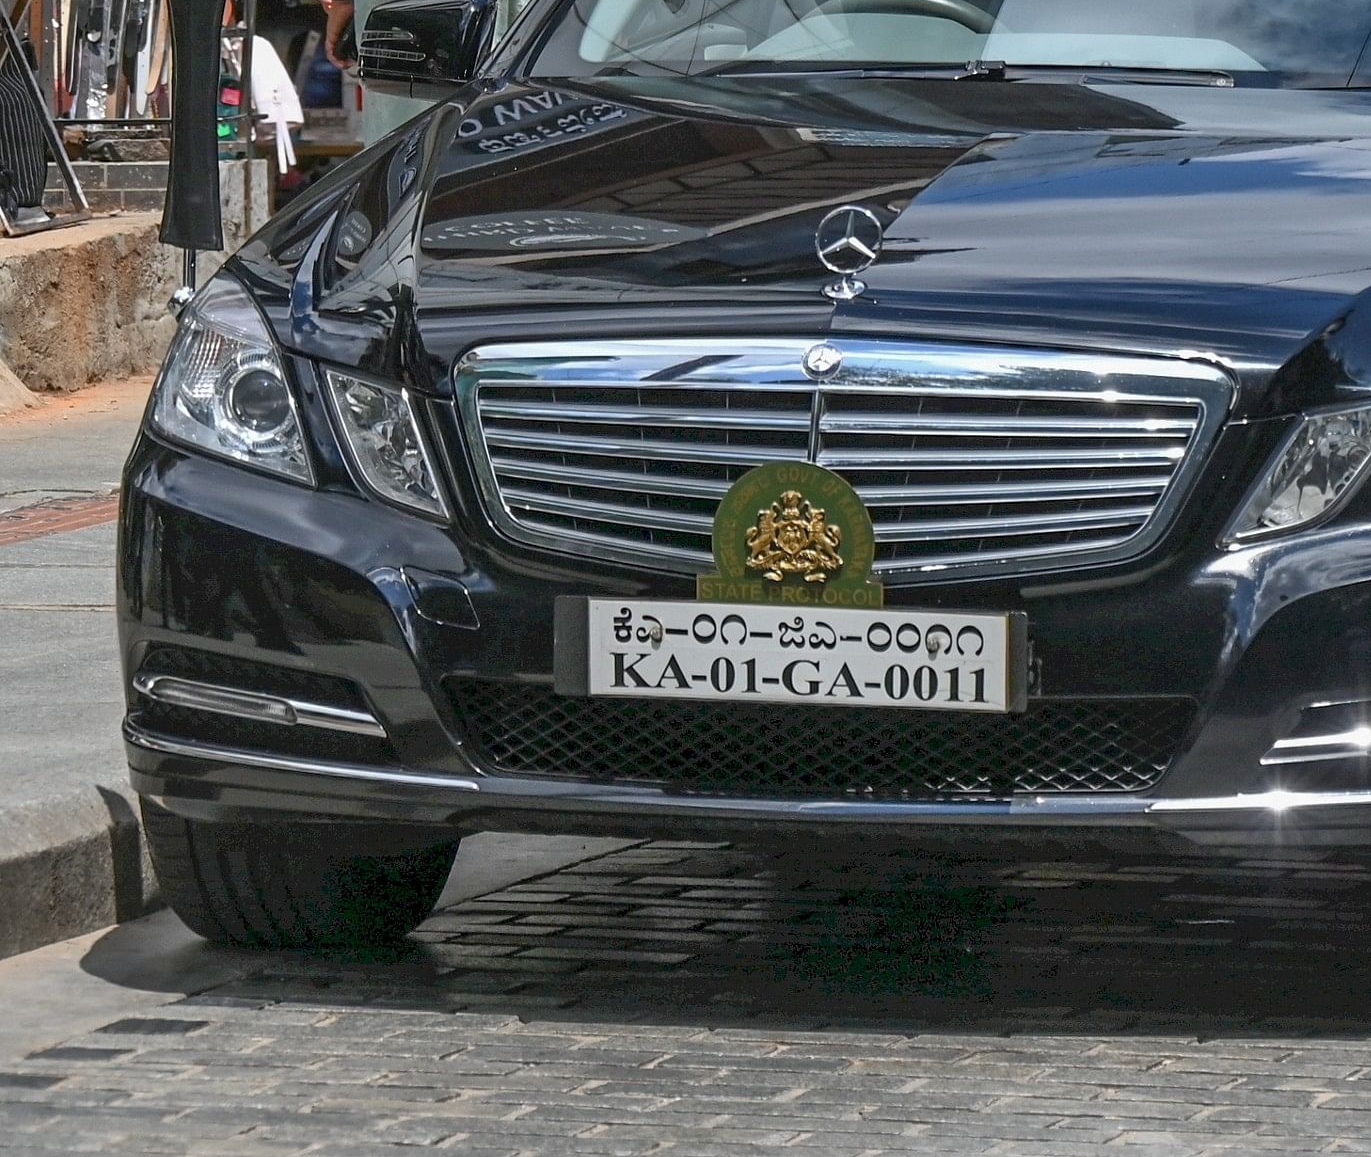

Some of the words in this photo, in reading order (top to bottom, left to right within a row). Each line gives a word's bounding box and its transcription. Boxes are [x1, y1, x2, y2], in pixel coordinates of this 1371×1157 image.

[701, 582, 762, 600] STATE
[768, 586, 878, 606] PROTOCOL
[610, 651, 990, 704] KA-01-GA-0011
